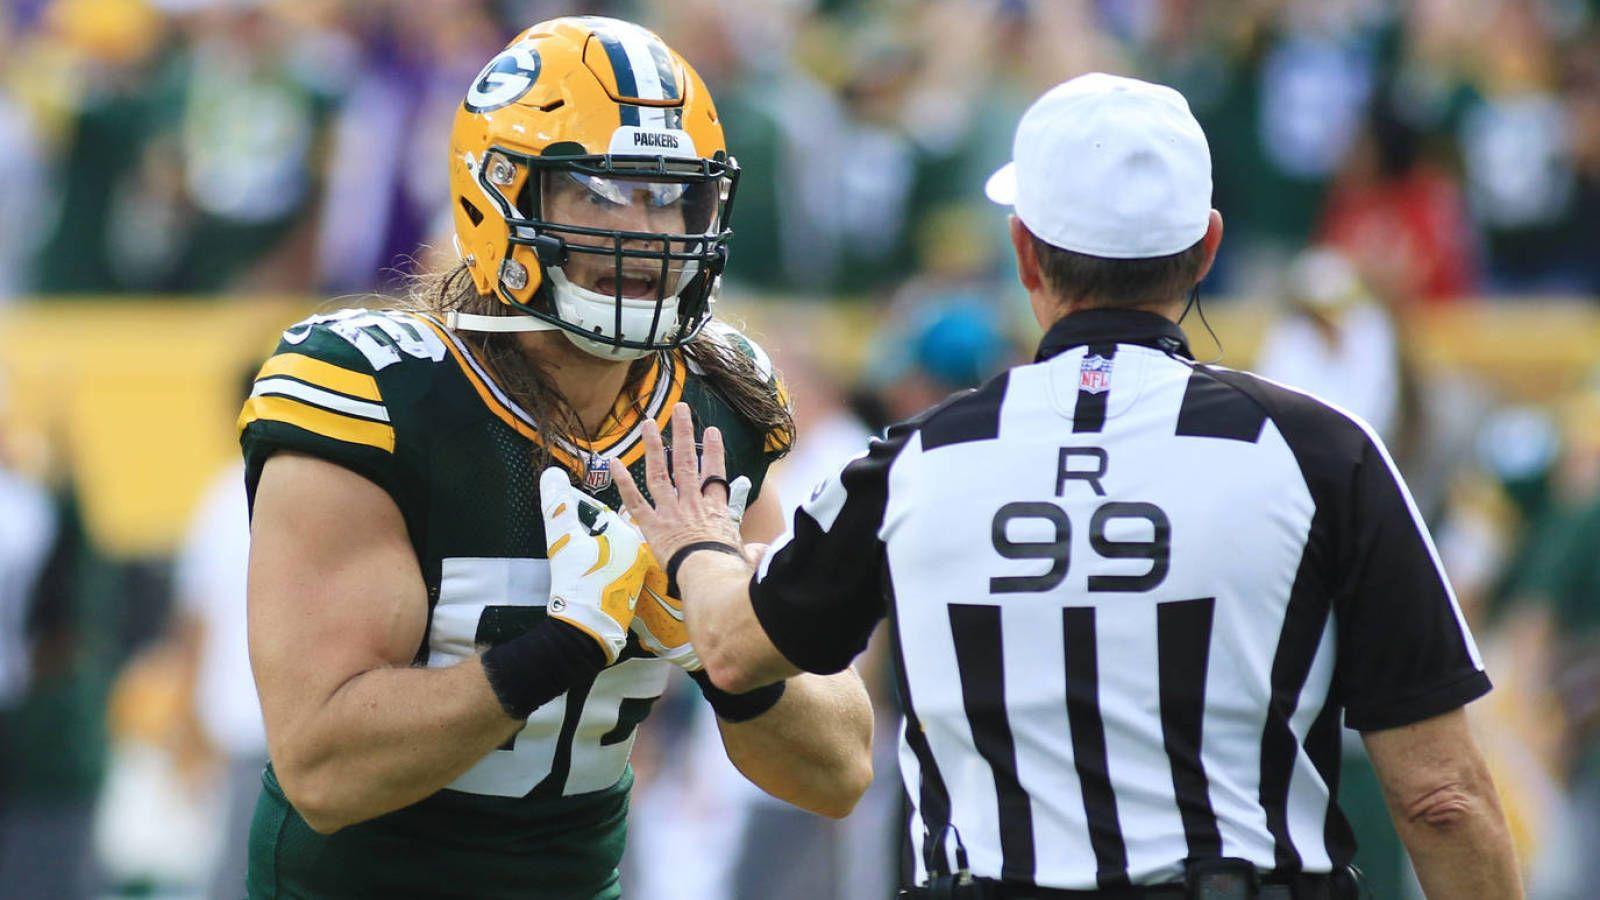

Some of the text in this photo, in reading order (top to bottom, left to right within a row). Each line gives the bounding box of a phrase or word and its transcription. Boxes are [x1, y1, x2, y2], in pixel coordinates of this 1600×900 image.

[633, 132, 679, 149] PACKERS
[1081, 371, 1109, 388] NFL
[585, 470, 609, 488] NFL
[1054, 446, 1110, 497] R
[989, 501, 1172, 594] 99
